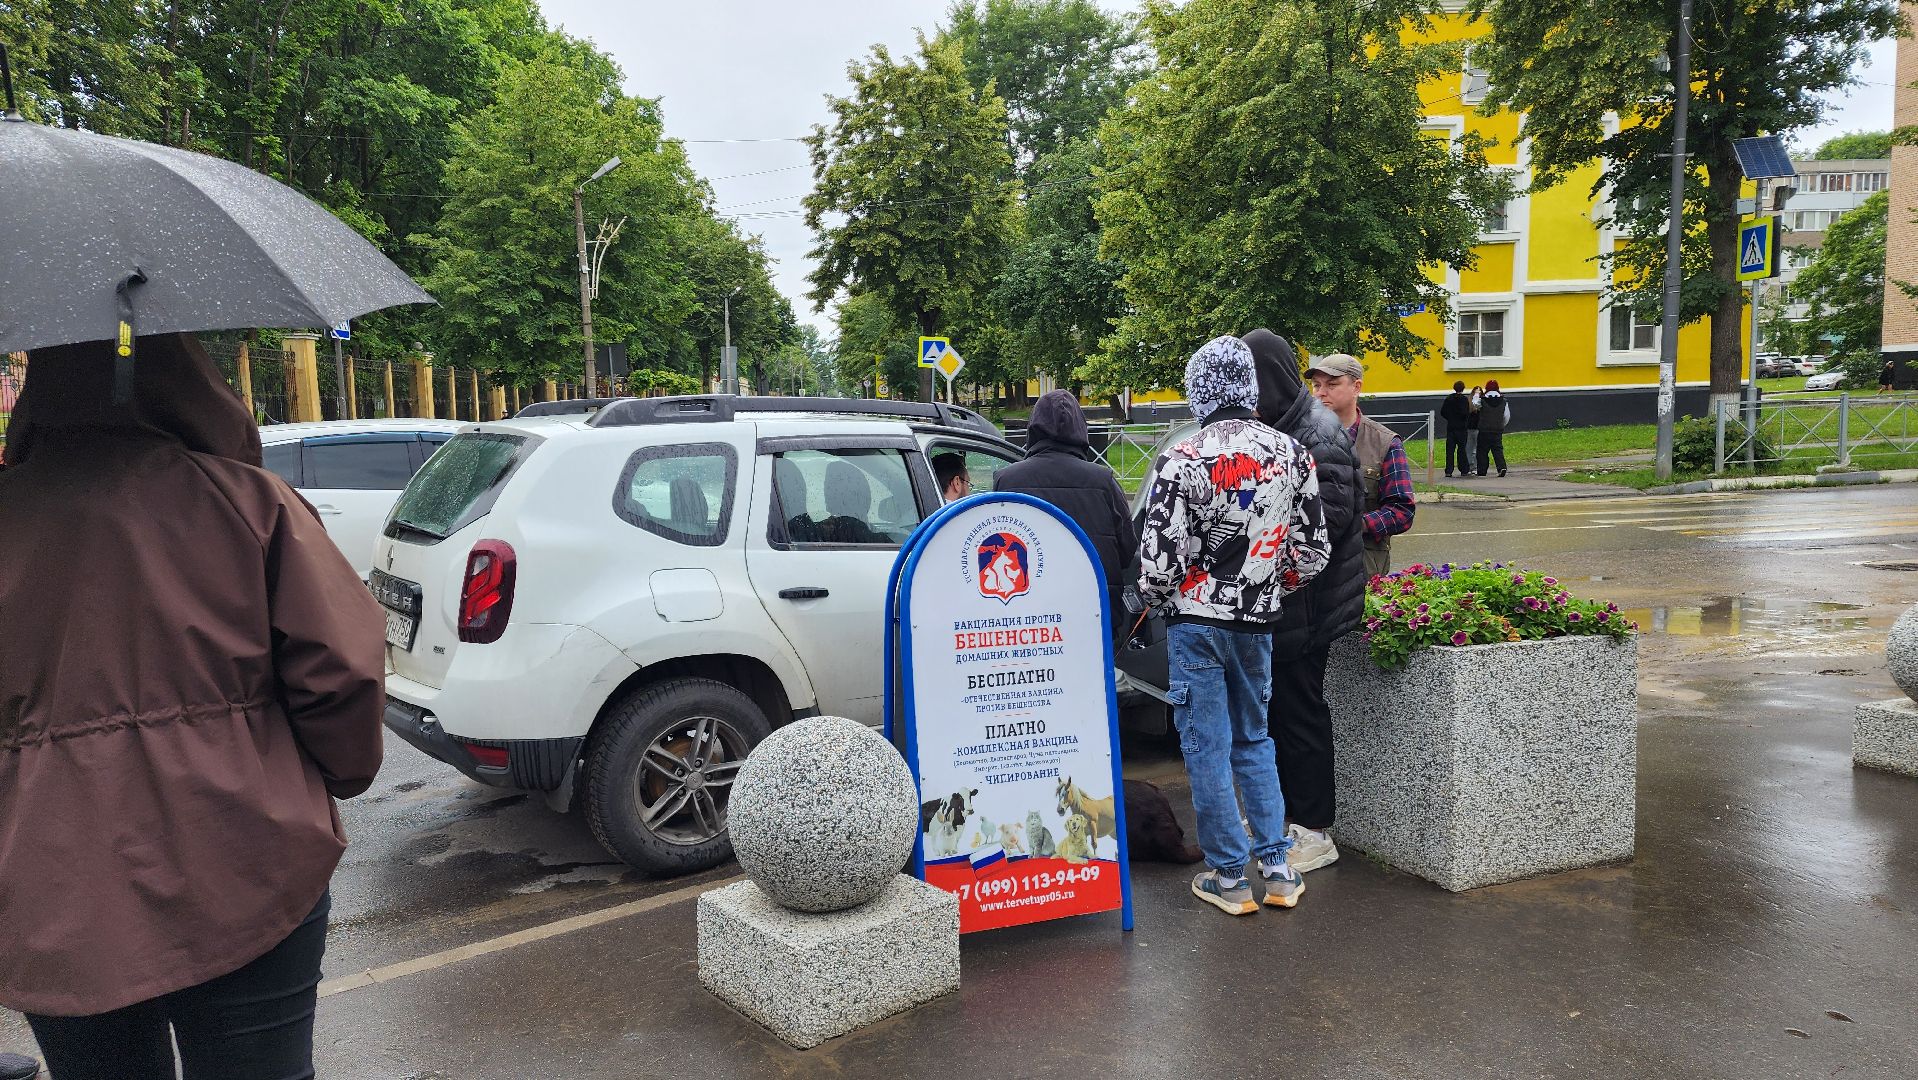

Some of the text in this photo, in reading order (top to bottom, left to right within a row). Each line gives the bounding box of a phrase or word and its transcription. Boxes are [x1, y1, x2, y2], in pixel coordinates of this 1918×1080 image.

[954, 613, 1062, 630] ВАКЦИНАЦИЯ ПРОТИВ
[954, 626, 1063, 650] БЕШЕНСТВА
[955, 645, 1064, 664] ДОМАШНИХ ЖИВОТНЫХ
[967, 668, 1055, 689] БЕСПЛАТНО
[1028, 687, 1064, 698] ВАКЦИНА
[975, 699, 1052, 713] ПРОТИВ БЕШЕНСТВА
[985, 719, 1046, 740] ПЛАТНО
[1032, 735, 1079, 748] ВАКЦИНА
[985, 767, 1060, 785] ЧИПИРОВАНИЕ
[952, 865, 1100, 902] +7 (499) 113-94-09
[980, 890, 1076, 913] www.tervetupr05.ru
